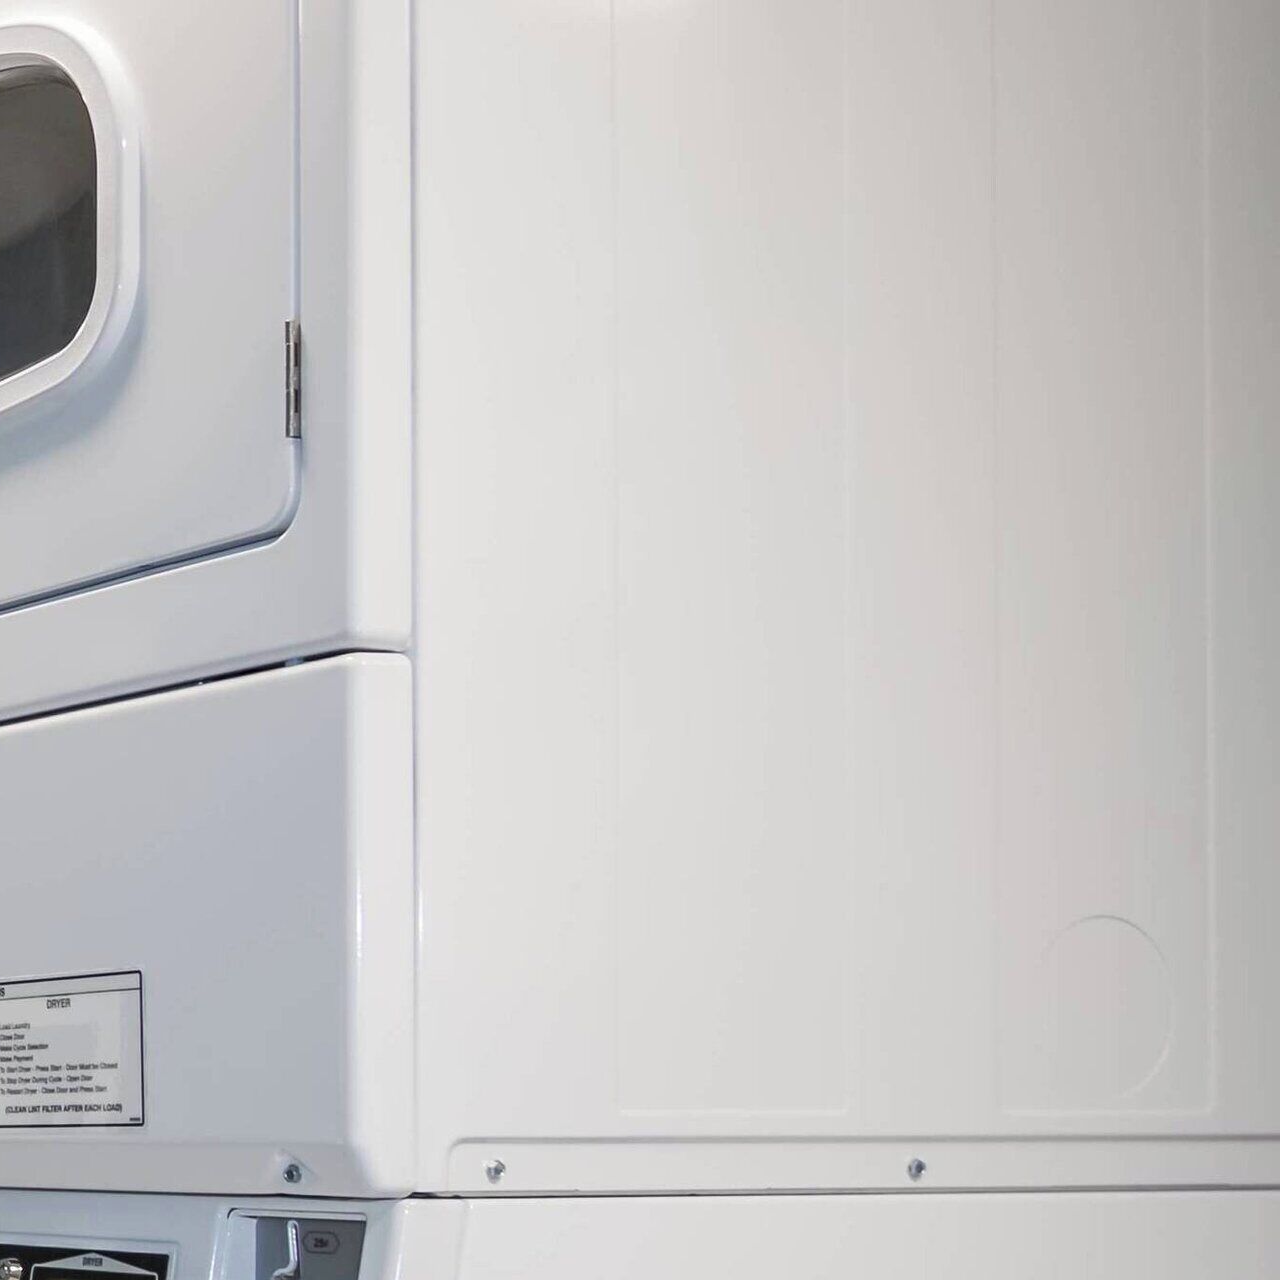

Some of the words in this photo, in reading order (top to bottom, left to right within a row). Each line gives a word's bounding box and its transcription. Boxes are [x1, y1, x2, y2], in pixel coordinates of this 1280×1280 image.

[46, 998, 71, 1009] DRYER
[42, 1105, 62, 1113] FILTER
[82, 1257, 103, 1267] DRYER
